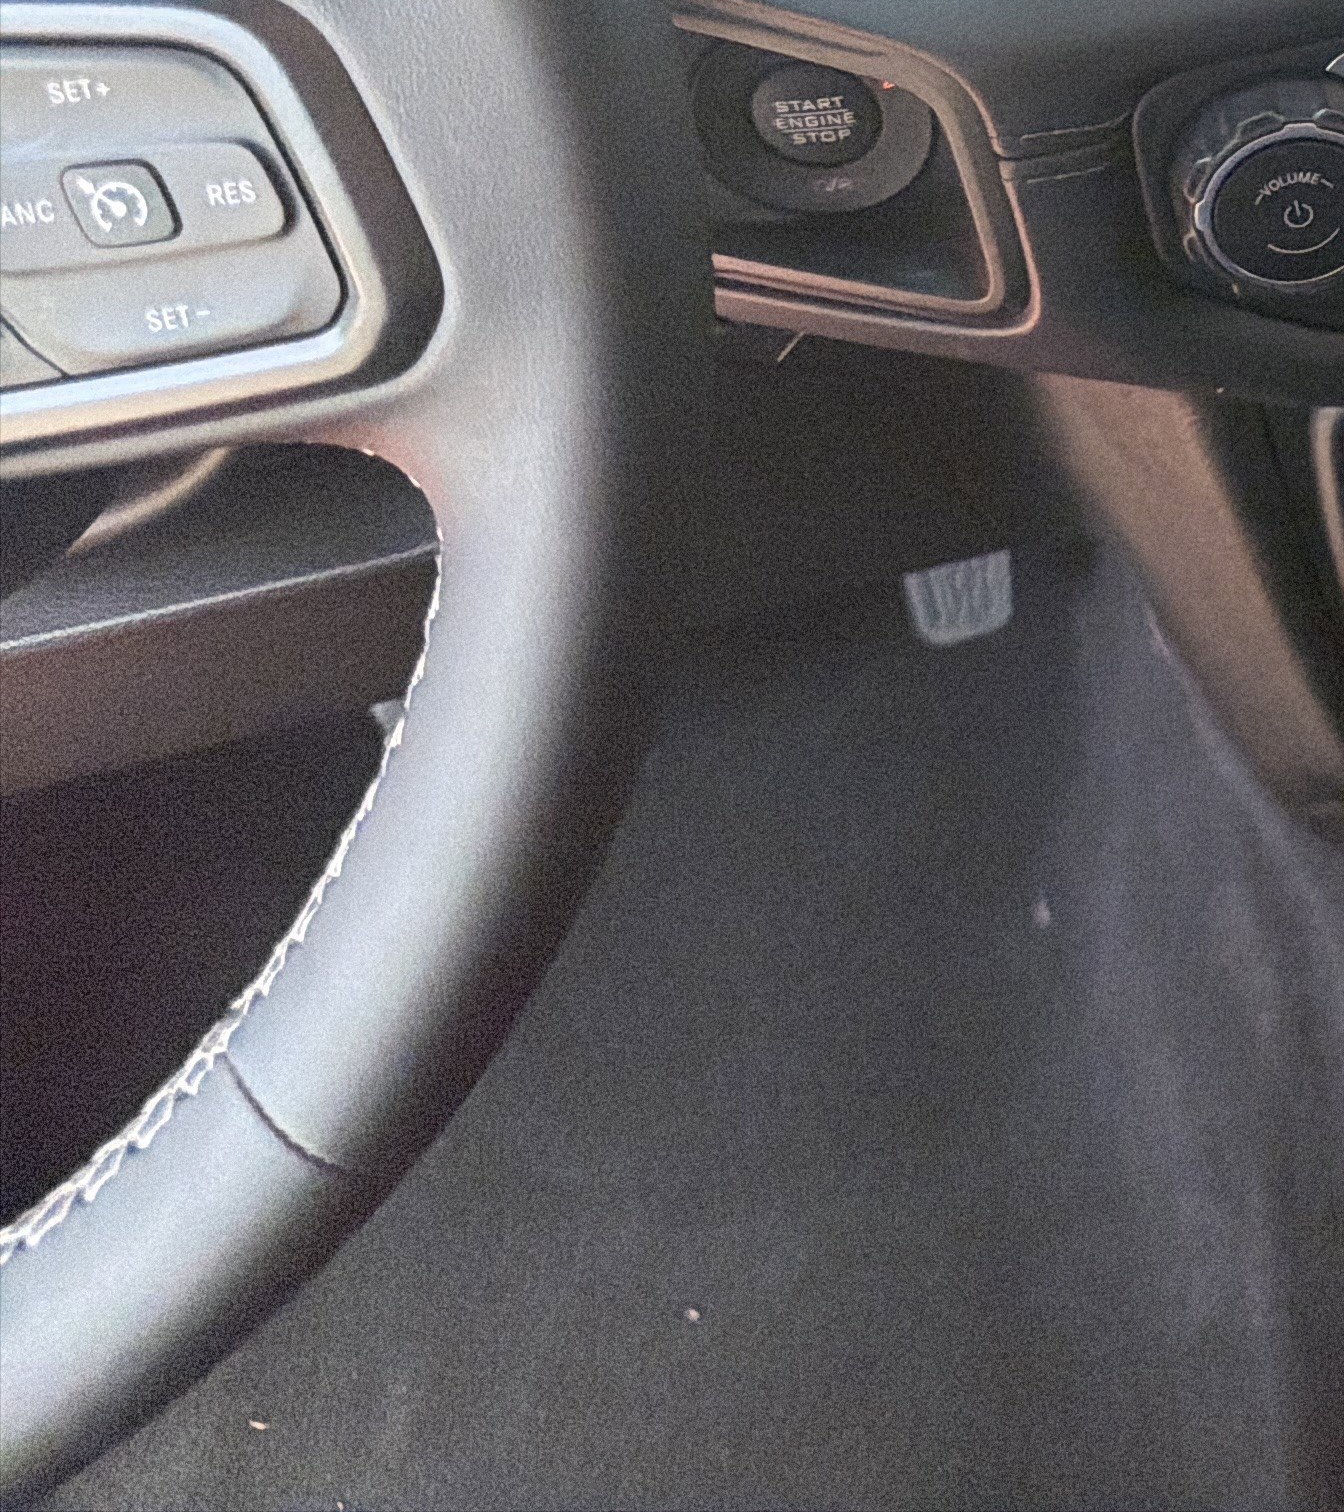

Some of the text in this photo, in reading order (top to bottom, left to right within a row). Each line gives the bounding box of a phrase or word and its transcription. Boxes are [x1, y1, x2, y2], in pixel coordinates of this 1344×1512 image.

[773, 95, 845, 114] START
[775, 111, 857, 129] ENGINE
[793, 129, 851, 146] STOP
[1259, 171, 1322, 197] VOLUME
[206, 181, 257, 207] RES
